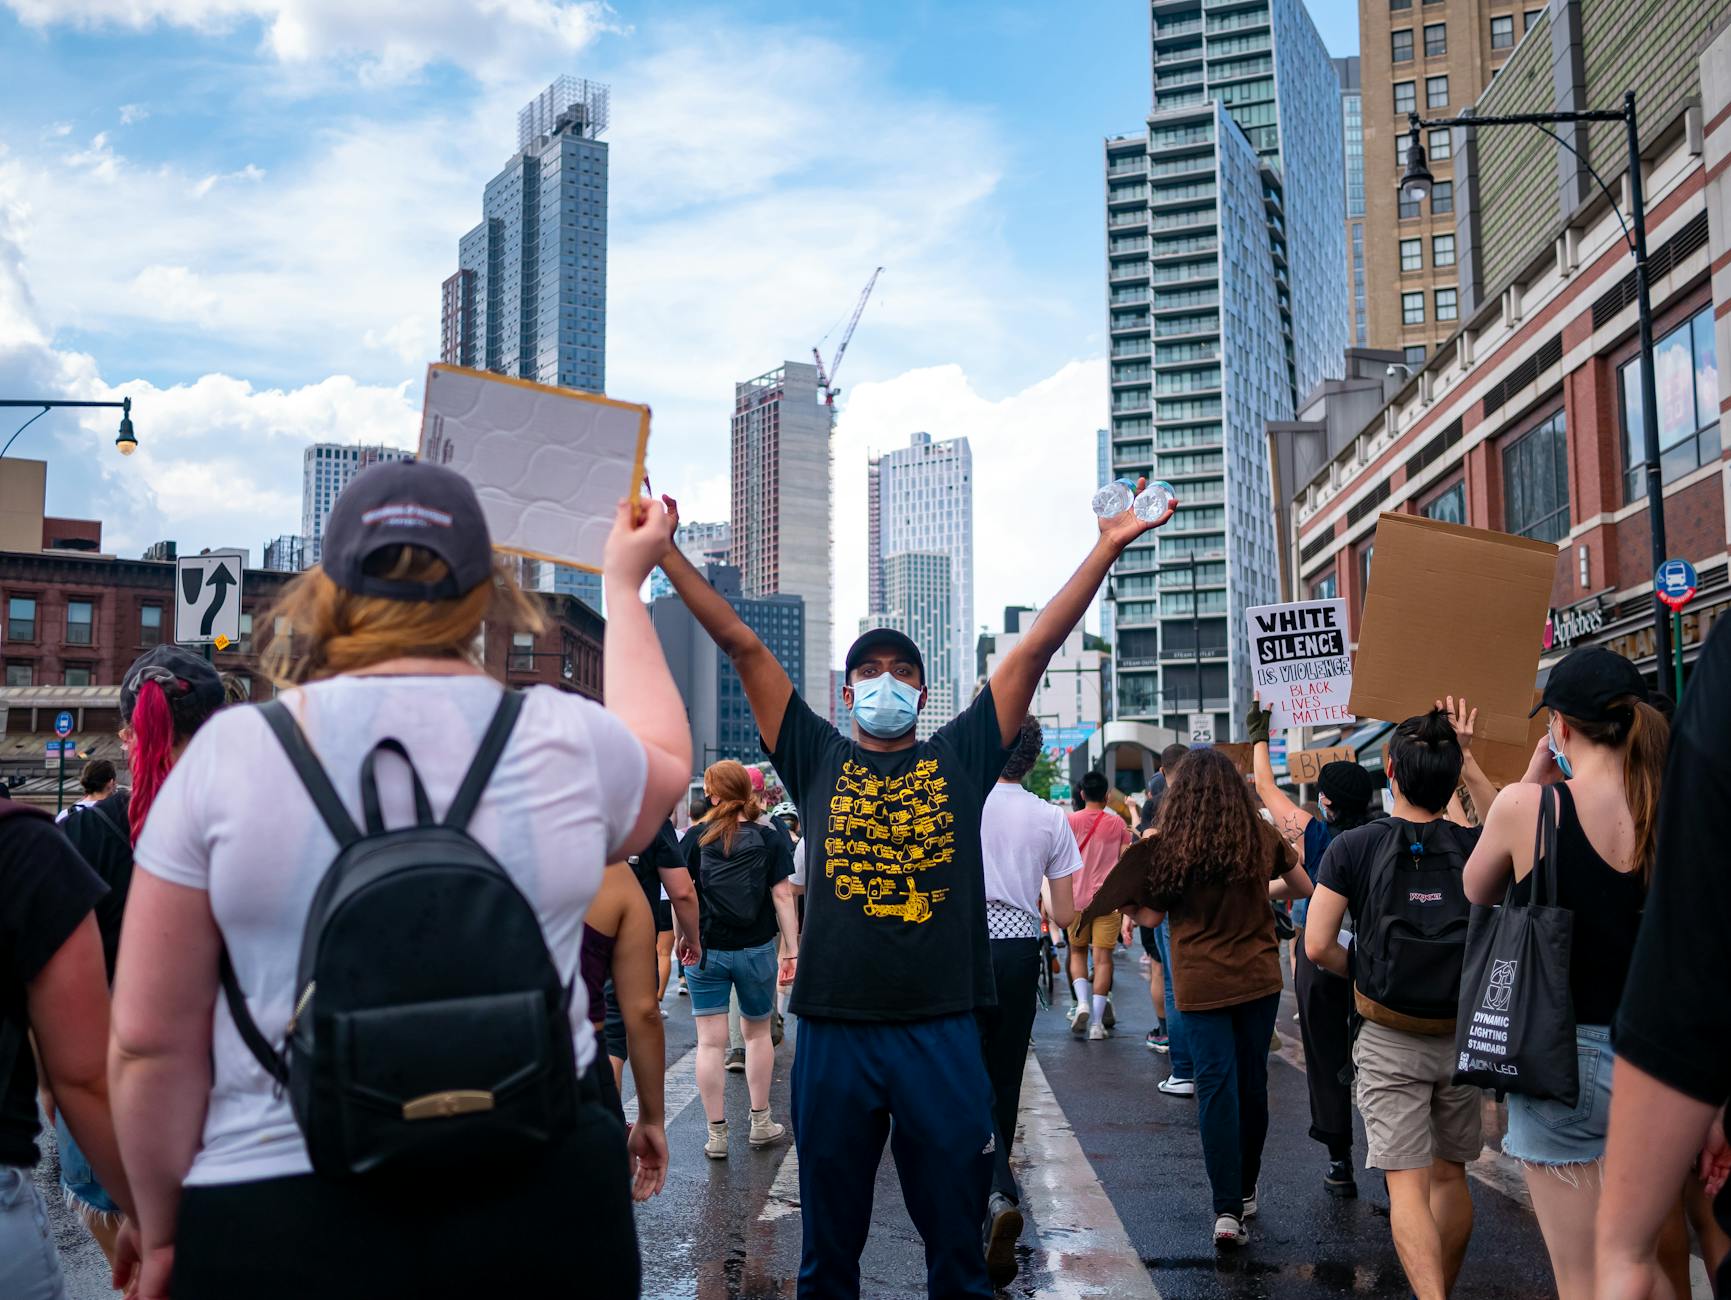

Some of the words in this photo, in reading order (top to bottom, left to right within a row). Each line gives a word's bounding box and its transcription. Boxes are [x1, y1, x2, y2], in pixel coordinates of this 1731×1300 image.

[1255, 606, 1337, 633] WHITE
[1260, 631, 1338, 662] SILENCE
[1257, 667, 1278, 686] IS
[1279, 656, 1352, 683] VIOLENCE
[1289, 681, 1334, 697] BLACK
[1281, 695, 1321, 712] LIVES
[1292, 704, 1352, 725] MATTER
[1193, 729, 1211, 741] 25
[1473, 1011, 1510, 1028] DYNAMIC
[1469, 1025, 1508, 1042] LIGHTING
[1467, 1039, 1507, 1056] STANDARD
